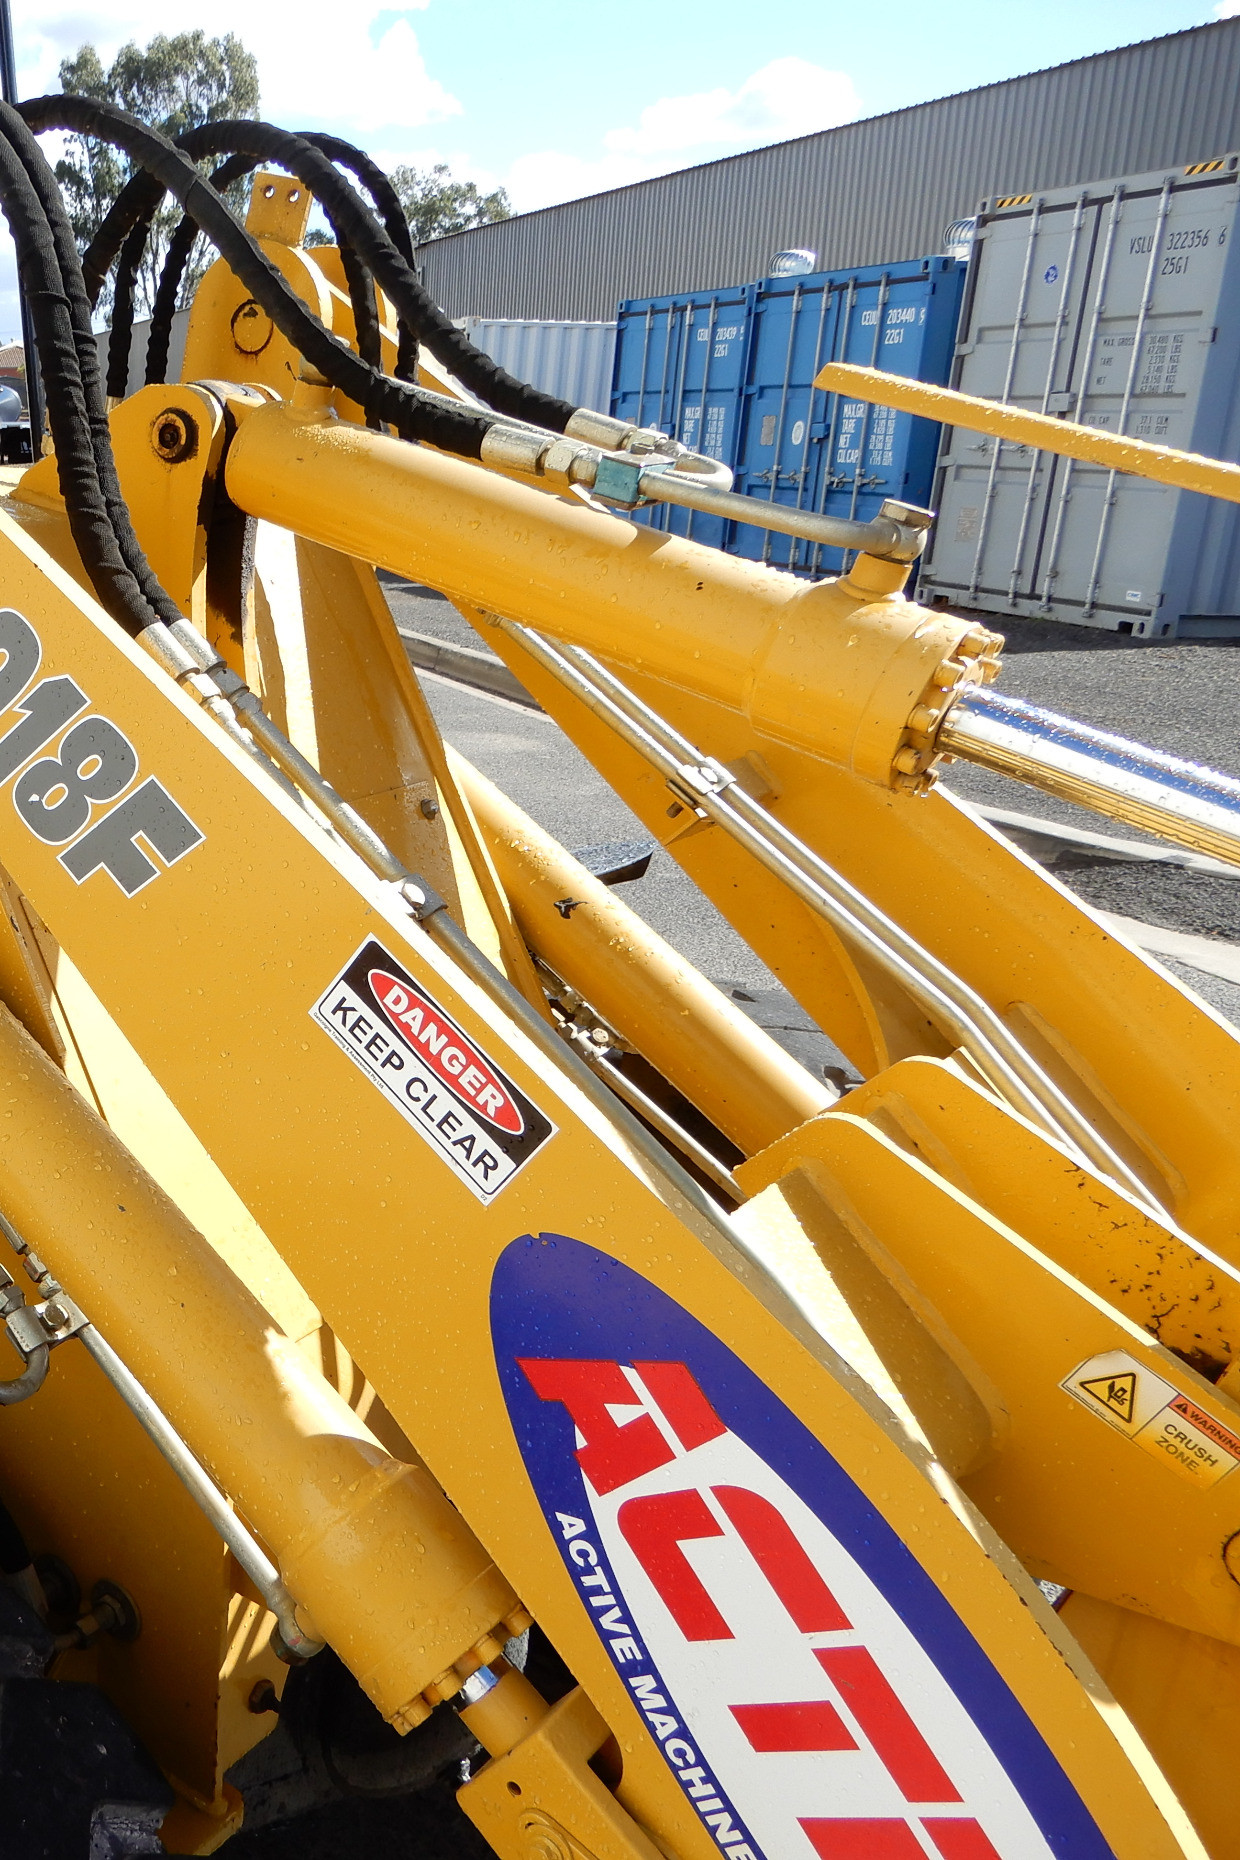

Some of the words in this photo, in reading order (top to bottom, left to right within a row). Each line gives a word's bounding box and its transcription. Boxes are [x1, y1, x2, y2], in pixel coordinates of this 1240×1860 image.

[1129, 235, 1155, 255] VSLU
[1166, 229, 1211, 250] 322356
[1218, 225, 1228, 245] 6
[1161, 256, 1190, 275] 25G1
[886, 307, 916, 324] 203440
[884, 328, 904, 345] 22G1
[382, 985, 506, 1119] DANGER
[330, 996, 405, 1072] KEEP
[405, 1076, 499, 1182] CLEAR
[1163, 1423, 1219, 1468] CRUSH
[554, 1511, 644, 1664] ACTIVE
[628, 1674, 758, 1860] MACHINE
